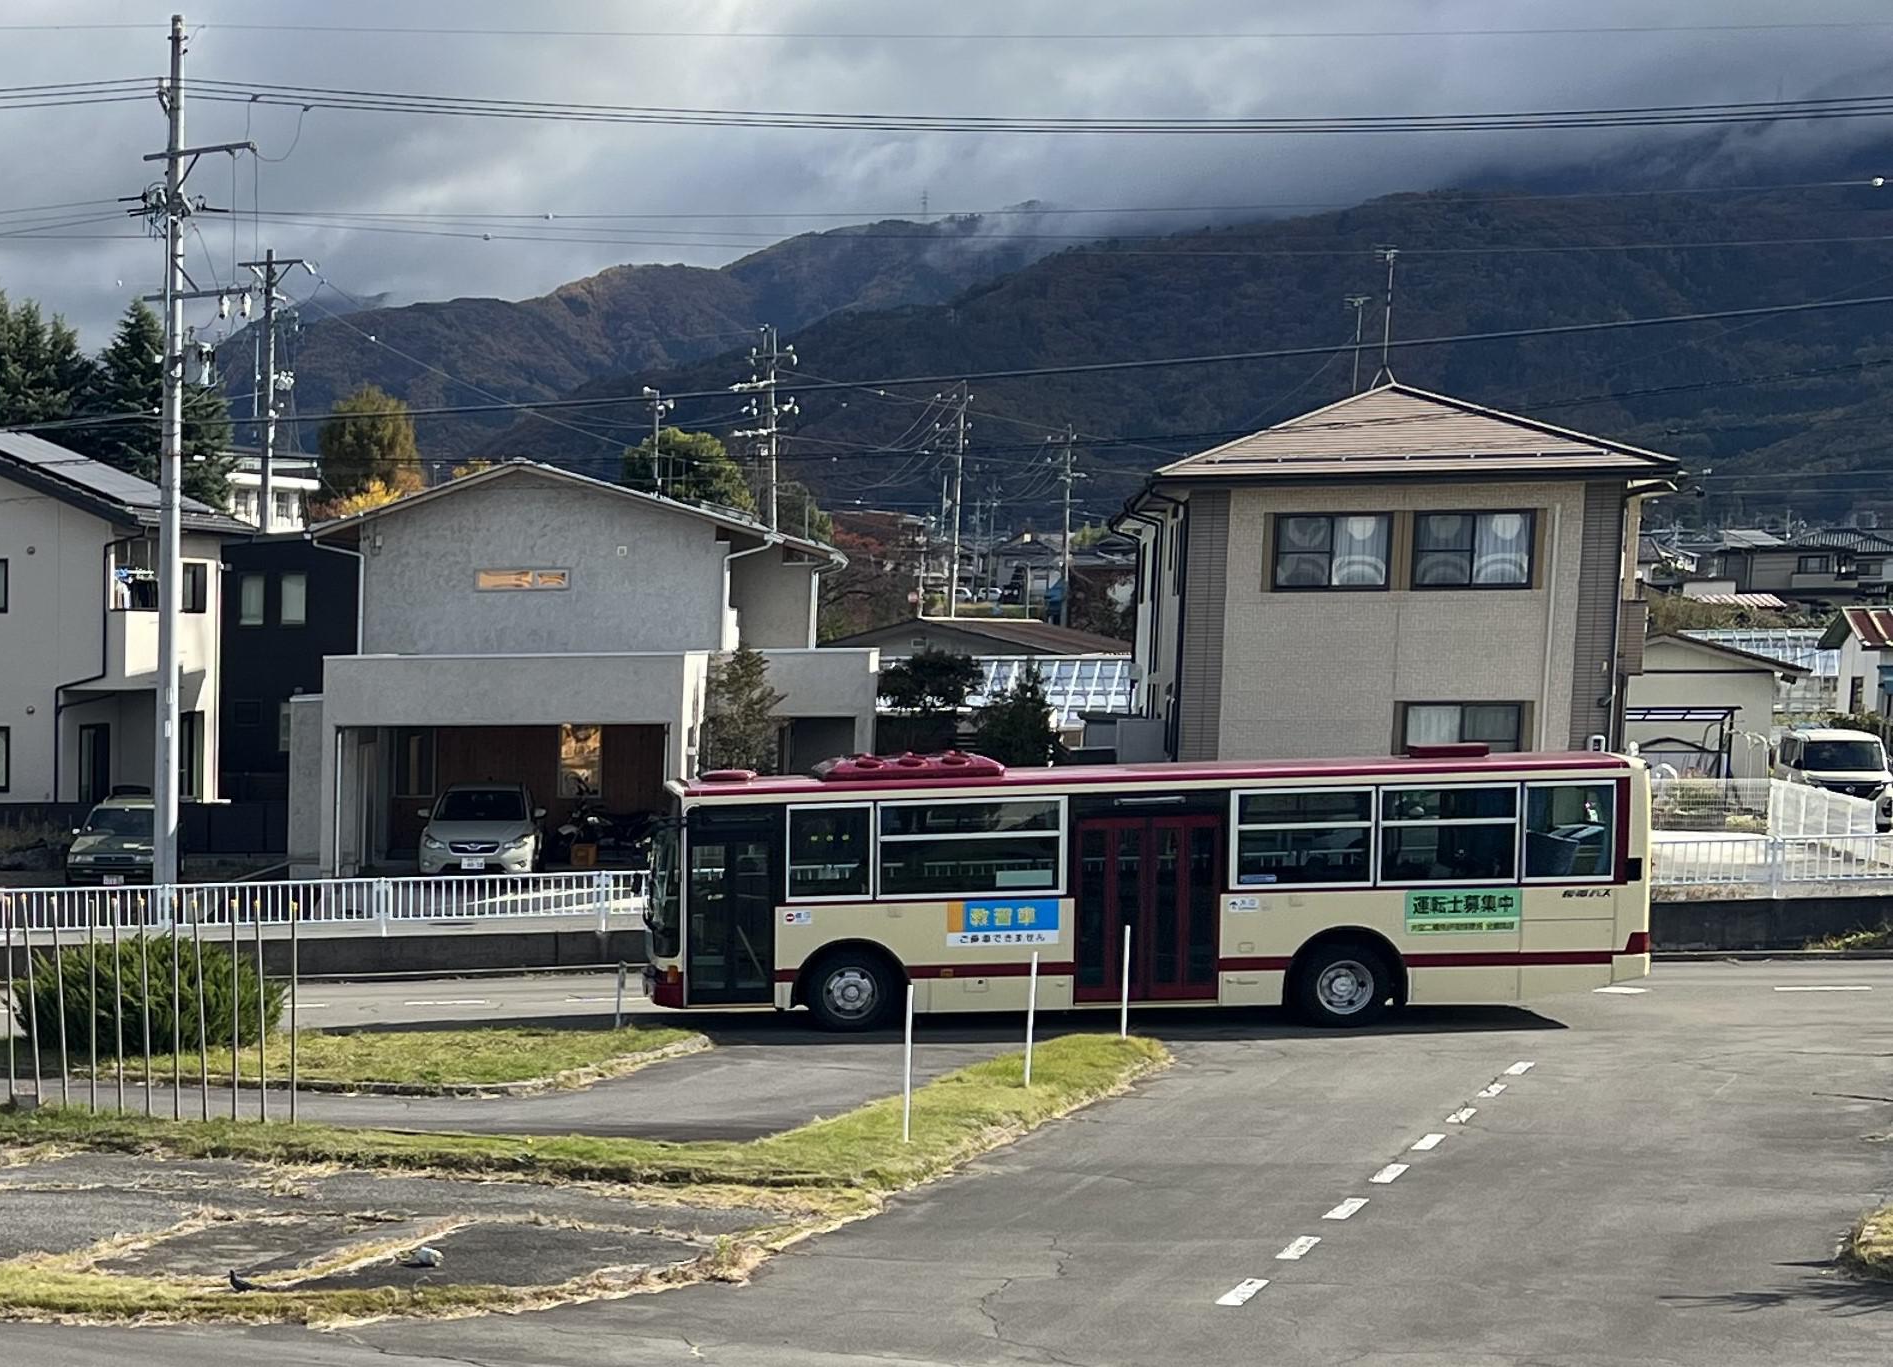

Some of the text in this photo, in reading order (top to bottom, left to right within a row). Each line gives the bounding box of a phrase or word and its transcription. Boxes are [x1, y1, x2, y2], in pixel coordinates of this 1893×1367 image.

[1412, 894, 1514, 915] 運転士募集中
